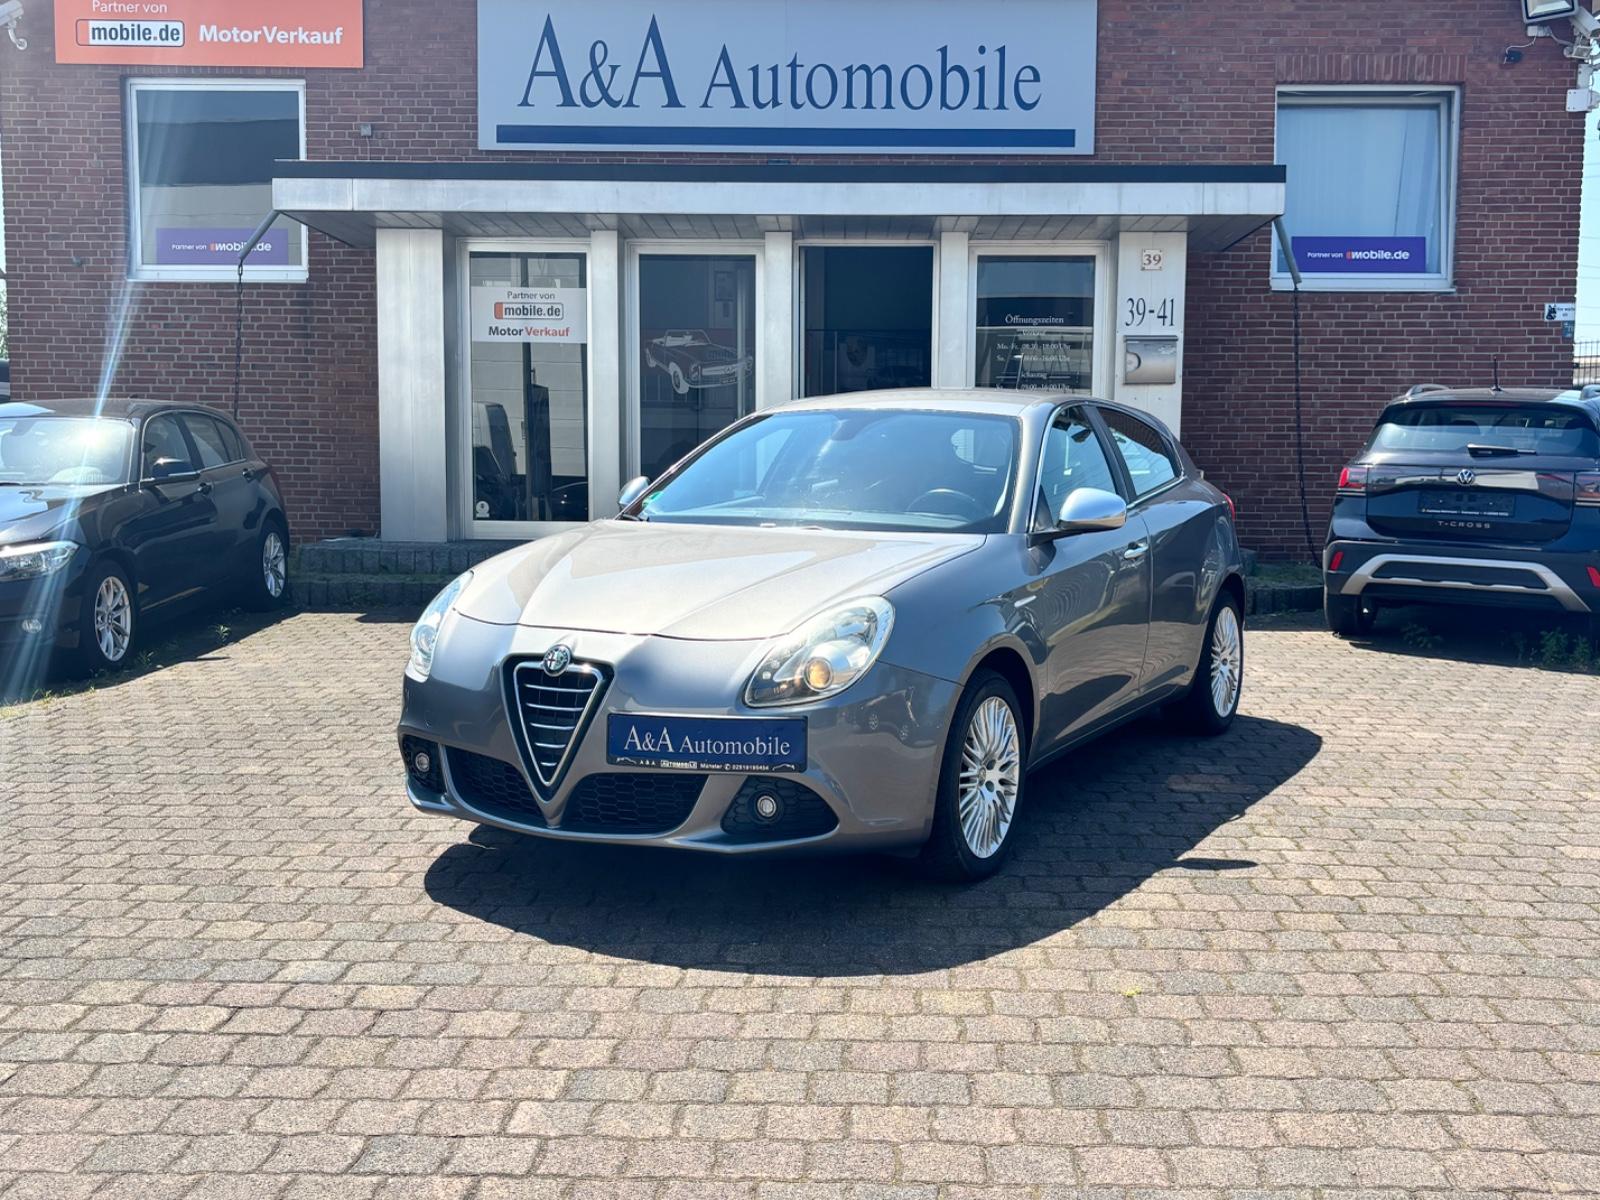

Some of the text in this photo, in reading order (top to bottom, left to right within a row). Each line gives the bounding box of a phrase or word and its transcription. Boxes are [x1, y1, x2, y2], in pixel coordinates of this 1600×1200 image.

[92, 0, 168, 13] Partner von
[91, 23, 344, 45] mobile.de MotorVerkauf
[517, 13, 1042, 111] A&A Automobile
[171, 243, 195, 251] Partner
[1143, 254, 1162, 266] 39
[1307, 251, 1331, 259] Partner
[1352, 249, 1410, 260] mobile.de
[507, 290, 556, 300] Partner von
[504, 304, 561, 317] mobile.de
[1125, 297, 1176, 327] 39-41
[1004, 312, 1065, 326] Öffnungszeiten
[1437, 520, 1491, 529] T-CROSS
[624, 725, 791, 756] A&A Automobile
